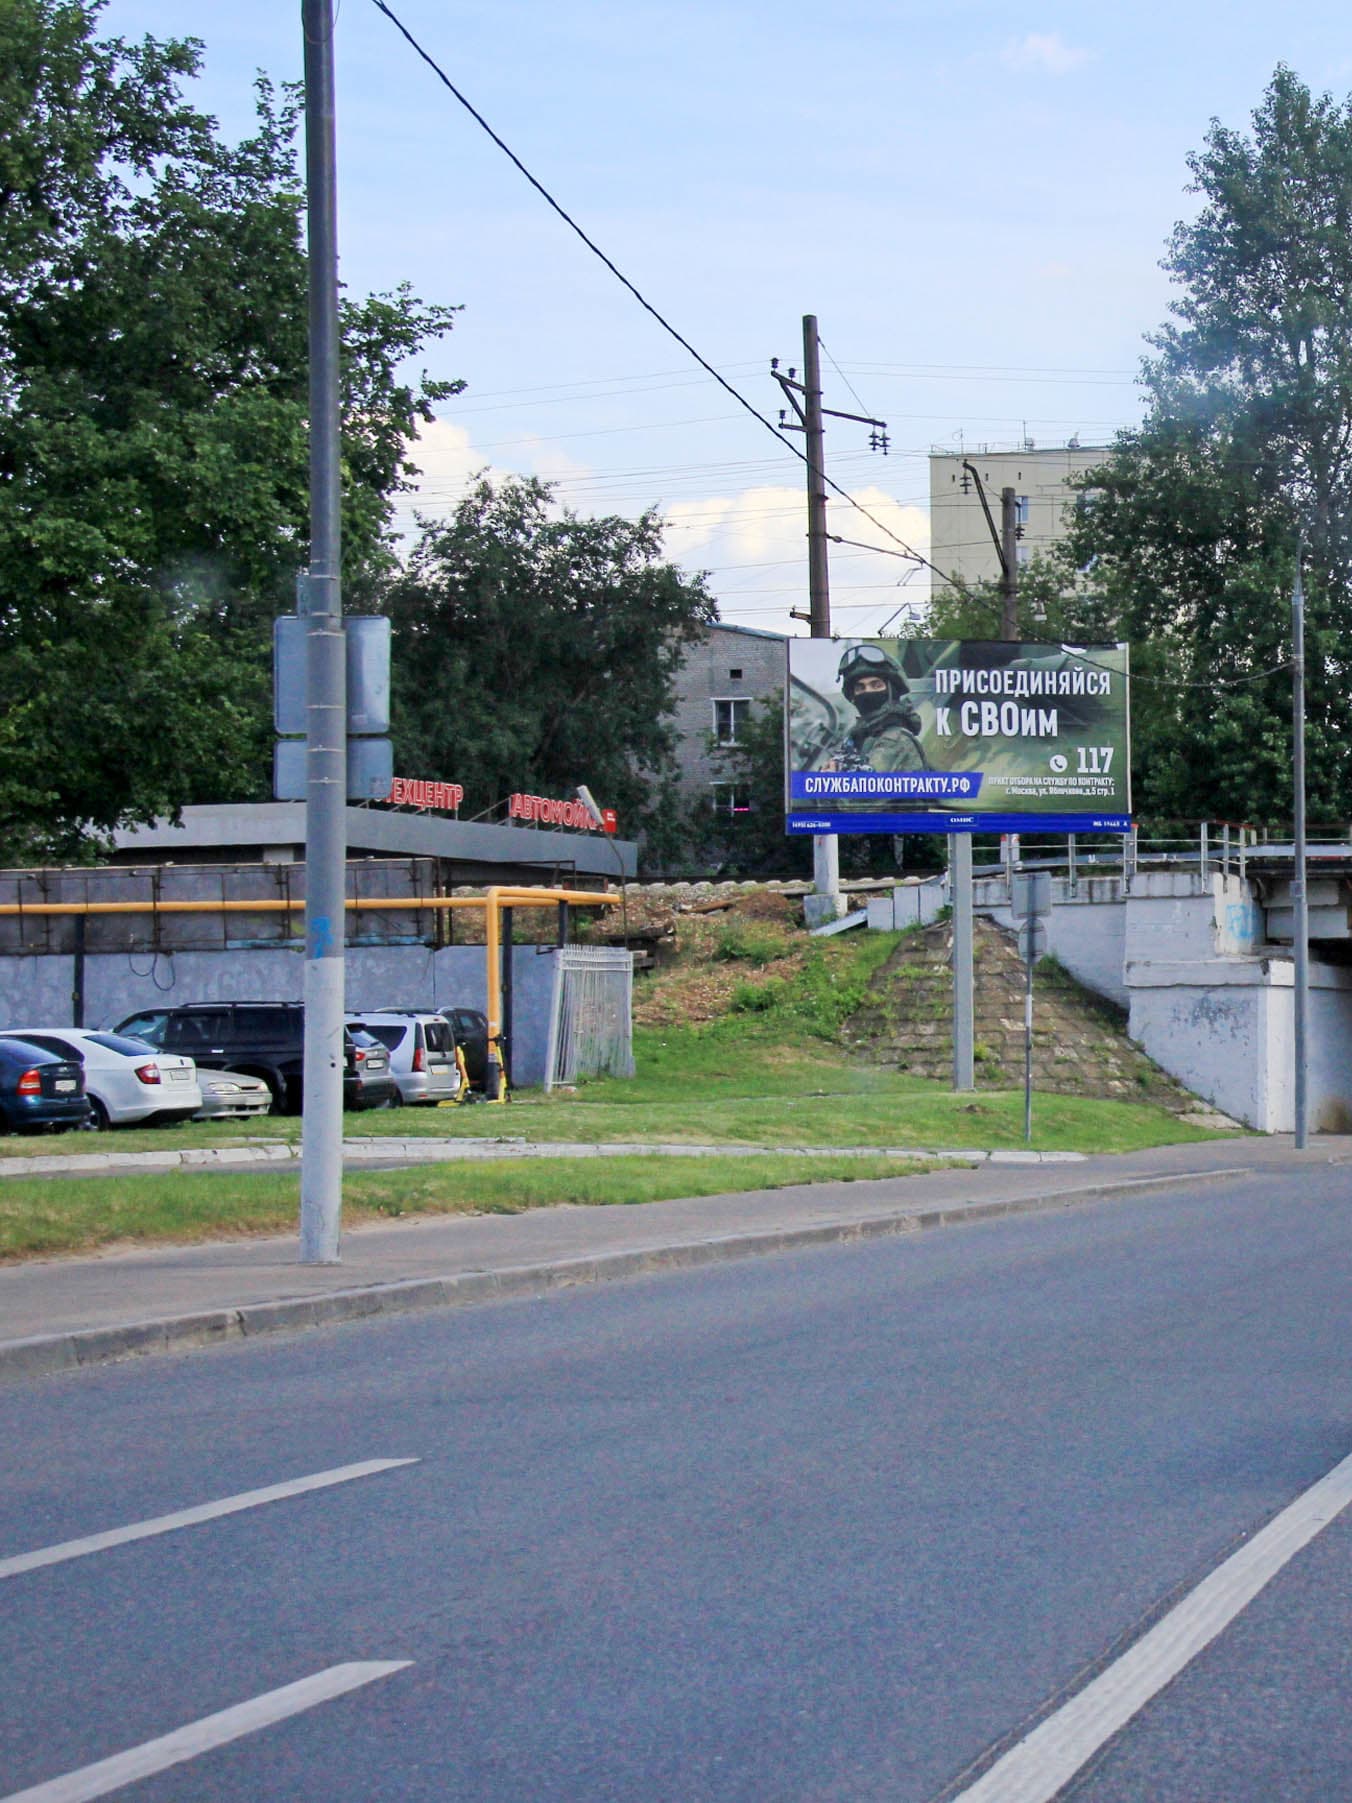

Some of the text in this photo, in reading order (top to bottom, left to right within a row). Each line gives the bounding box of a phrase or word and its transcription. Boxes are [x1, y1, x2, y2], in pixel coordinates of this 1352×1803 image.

[935, 666, 1112, 697] ПРИСОЕДИНЯЙСЯ
[1077, 747, 1115, 773] 117
[386, 776, 464, 811] ЕХЦЕНТР
[804, 776, 971, 794] СЛУЖБАПОКОНТРАКТУ.РФ
